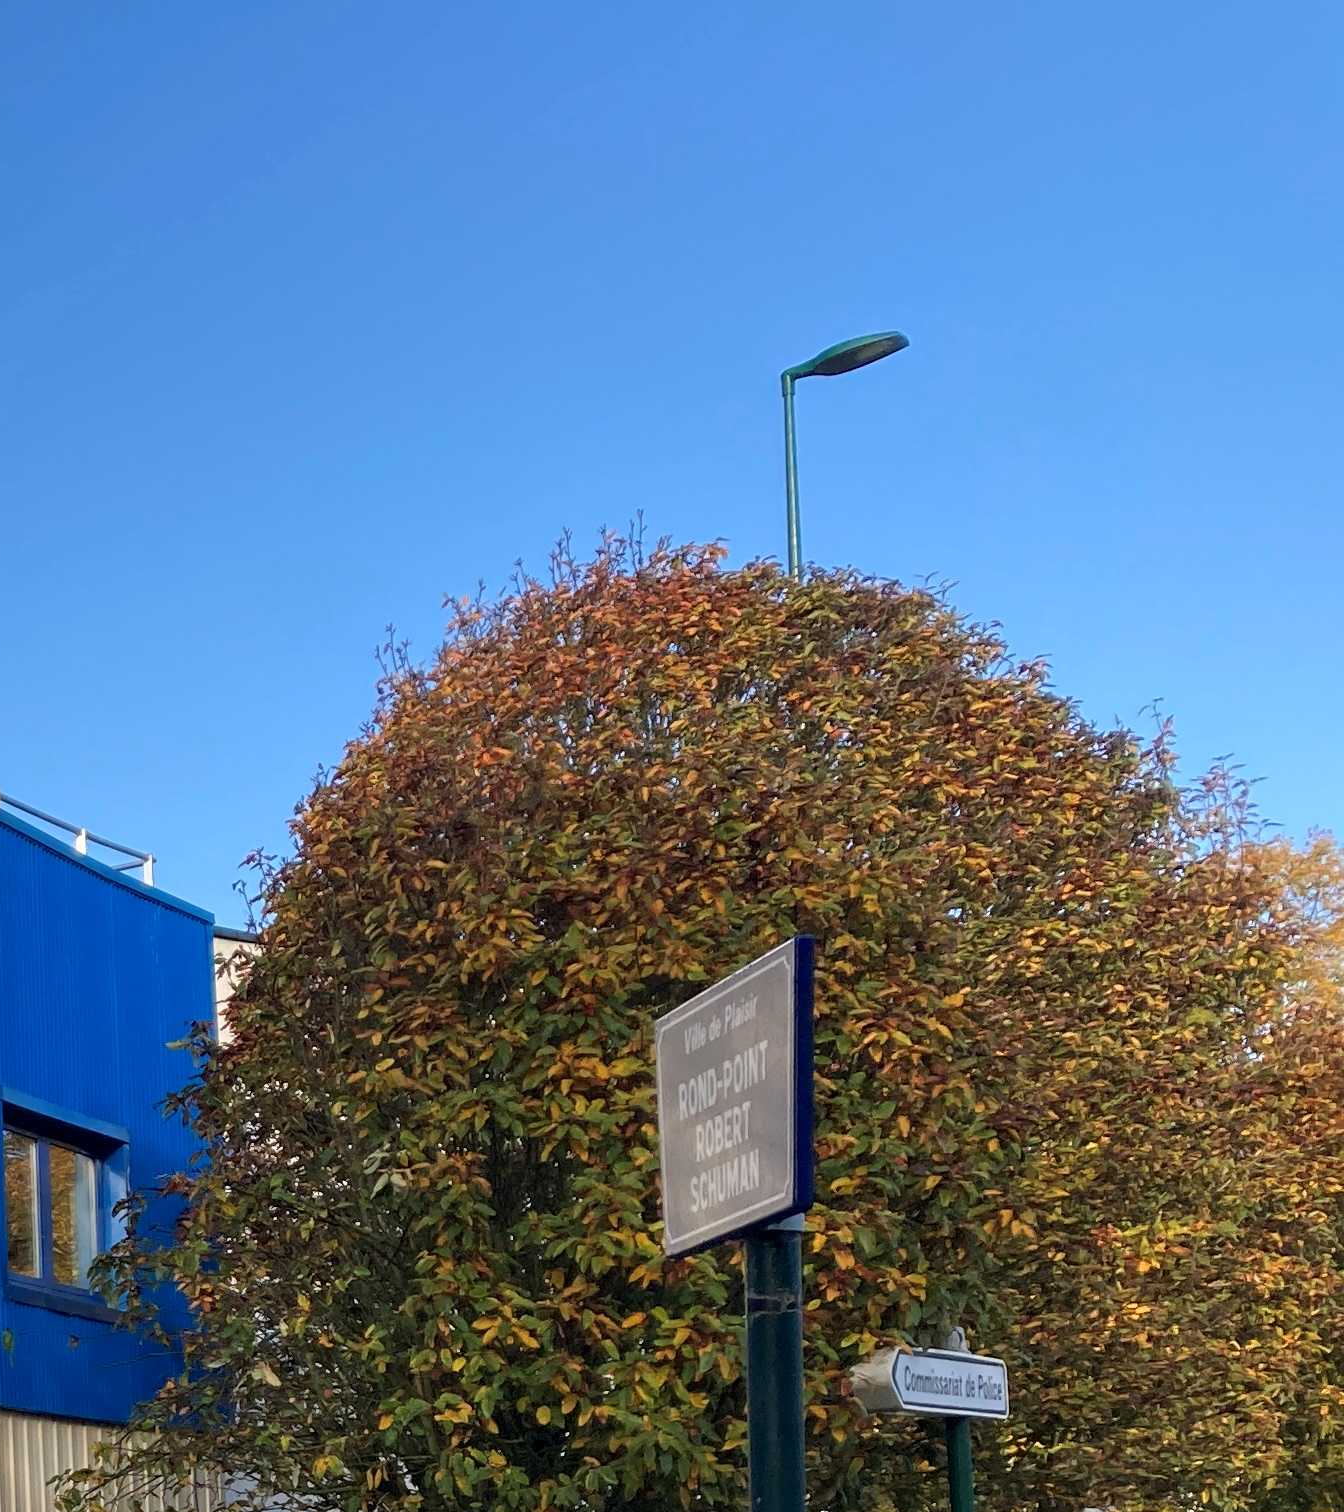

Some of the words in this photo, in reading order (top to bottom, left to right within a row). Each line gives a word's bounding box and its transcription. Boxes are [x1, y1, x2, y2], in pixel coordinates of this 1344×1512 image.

[684, 1022, 708, 1055] Ville
[708, 1015, 722, 1041] de
[724, 994, 759, 1034] Plaisir
[678, 1040, 769, 1121] ROND-POINT
[695, 1101, 753, 1162] ROBERT
[689, 1147, 760, 1213] SCHUMAN
[904, 1366, 963, 1397] Commissariat
[965, 1375, 976, 1399] de
[977, 1373, 1003, 1401] Police
